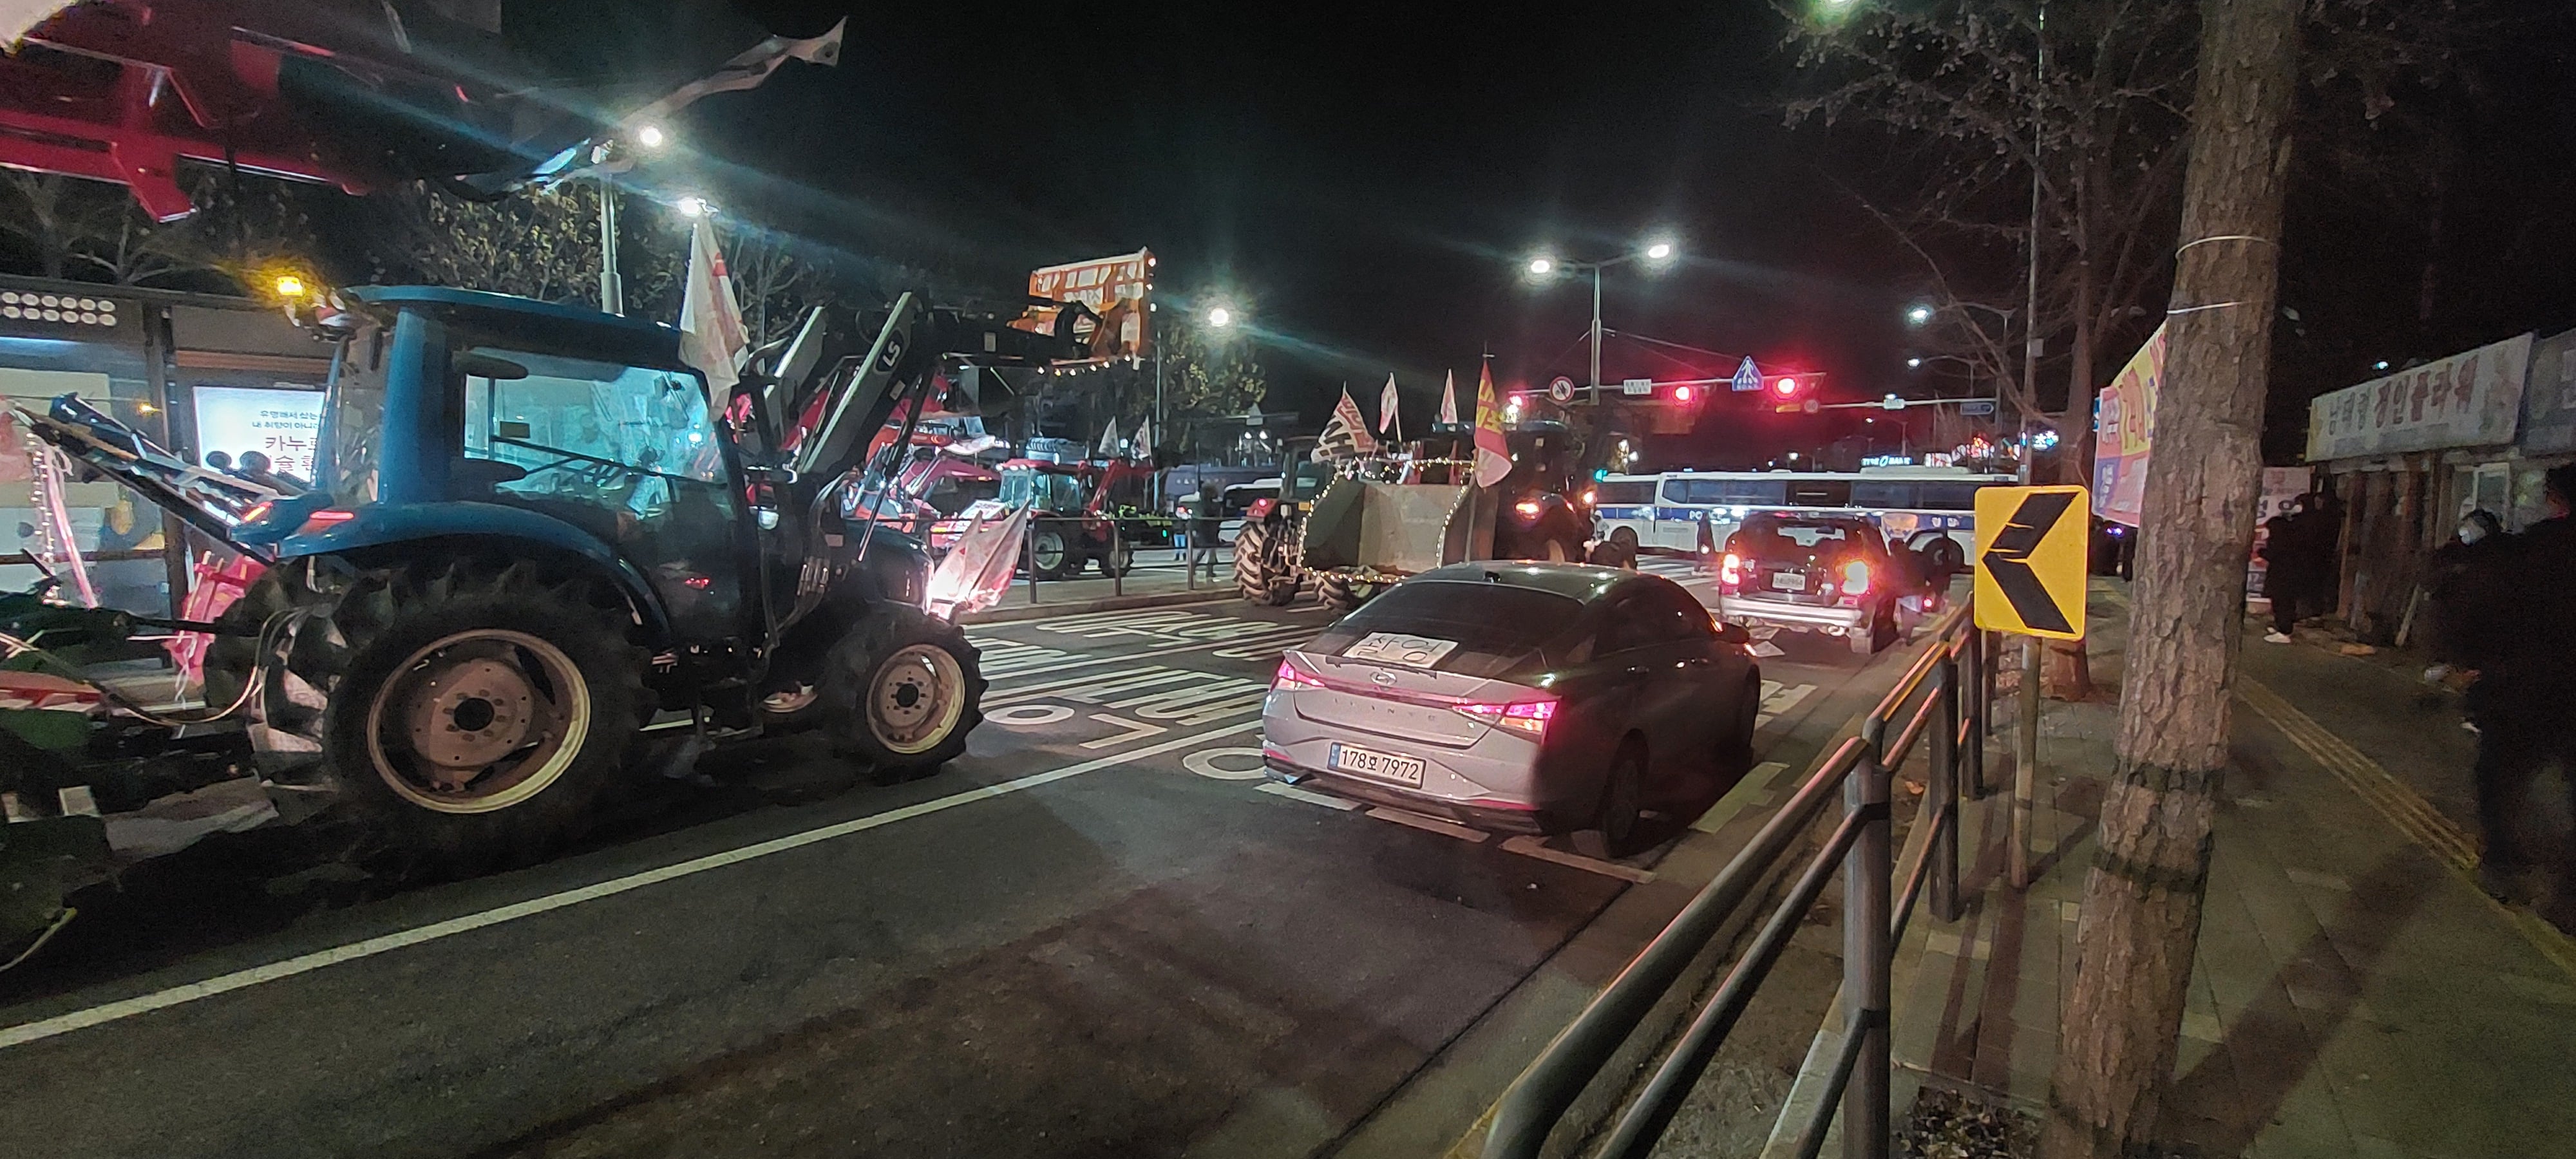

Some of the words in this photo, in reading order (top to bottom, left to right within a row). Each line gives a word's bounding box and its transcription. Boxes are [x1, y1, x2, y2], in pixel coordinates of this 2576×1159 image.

[883, 341, 901, 367] LS
[1342, 749, 1378, 771] 178호
[1382, 757, 1419, 780] 7972
